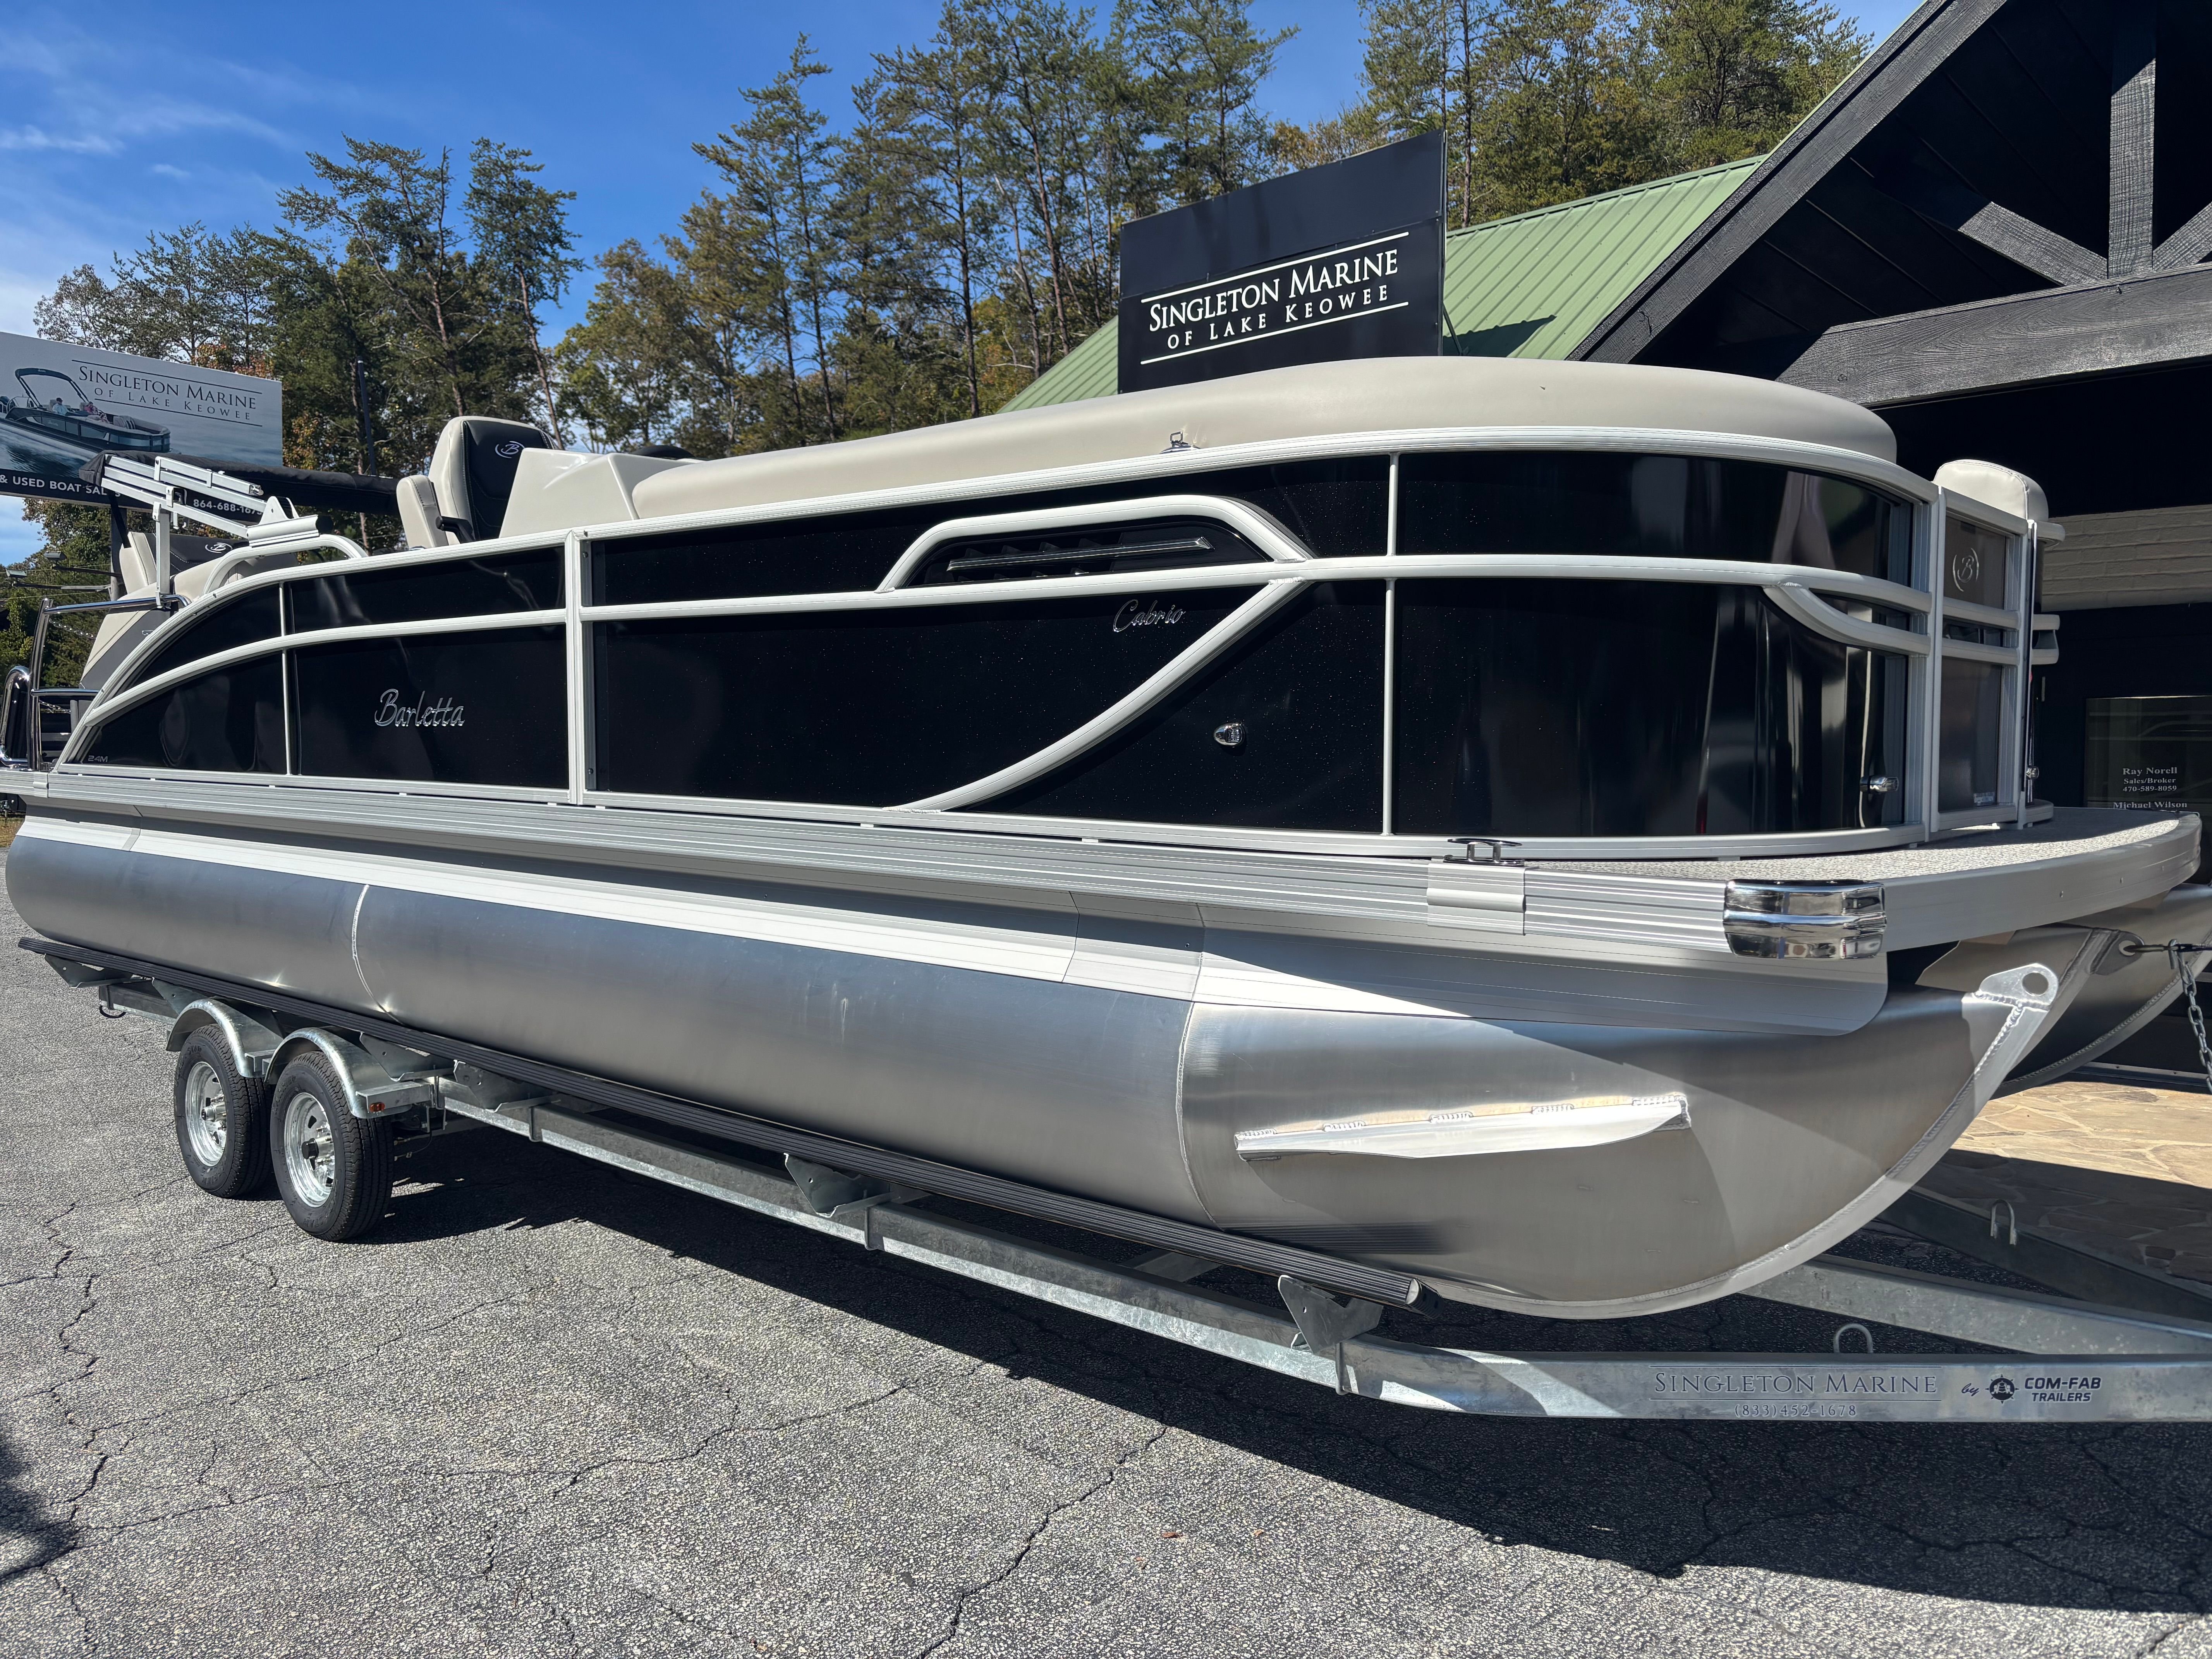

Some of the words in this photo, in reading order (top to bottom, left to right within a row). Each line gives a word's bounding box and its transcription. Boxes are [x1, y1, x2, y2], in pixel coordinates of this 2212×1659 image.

[1149, 278, 1280, 332] SINGLETON
[1288, 249, 1398, 299] MARINE
[1167, 330, 1192, 349] OF
[1209, 313, 1266, 340] LAKE
[1285, 285, 1388, 323] KEOWEE
[79, 366, 179, 396] SINGLETON
[187, 384, 256, 409] MARINE
[94, 388, 114, 398] OF
[129, 392, 170, 407] LAKE
[184, 401, 250, 420] KEOWEE
[0, 474, 8, 483] &
[13, 476, 45, 488] USED
[50, 481, 81, 492] BOAT
[86, 485, 121, 497] SALS
[1113, 599, 1186, 632] Cabrio
[374, 689, 465, 727] Barletta
[2123, 768, 2142, 776] Ray
[1655, 1372, 1815, 1393] SINGLETON
[1824, 1373, 1937, 1393] MARINE
[1961, 1382, 1980, 1397] by
[2024, 1377, 2101, 1389] COM-FAB
[2032, 1392, 2092, 1401] TRAILERS
[1735, 1404, 1856, 1418] (833)452-1678
